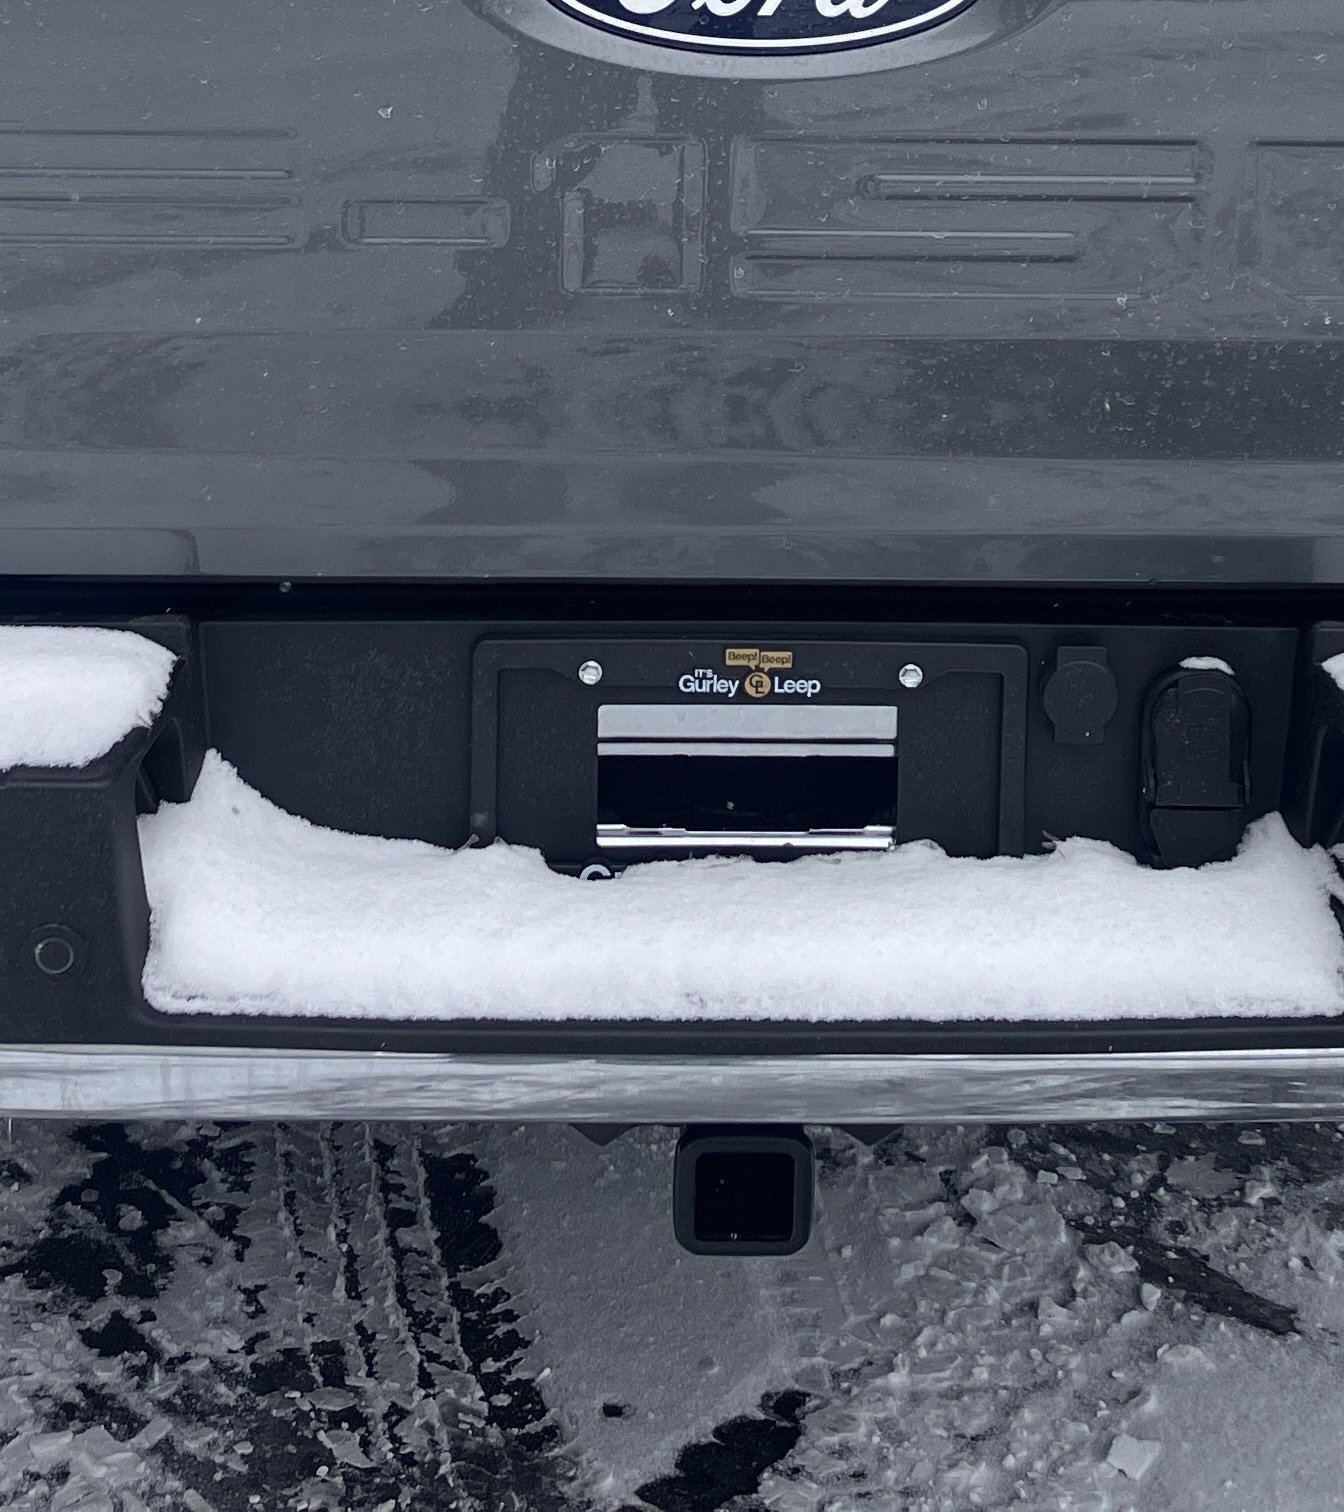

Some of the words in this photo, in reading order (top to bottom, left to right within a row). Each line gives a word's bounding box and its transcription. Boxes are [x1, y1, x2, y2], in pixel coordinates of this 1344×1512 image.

[728, 651, 758, 664] Beep!
[761, 654, 792, 666] Beep!
[678, 674, 740, 698] Gurley
[774, 676, 821, 698] Leep
